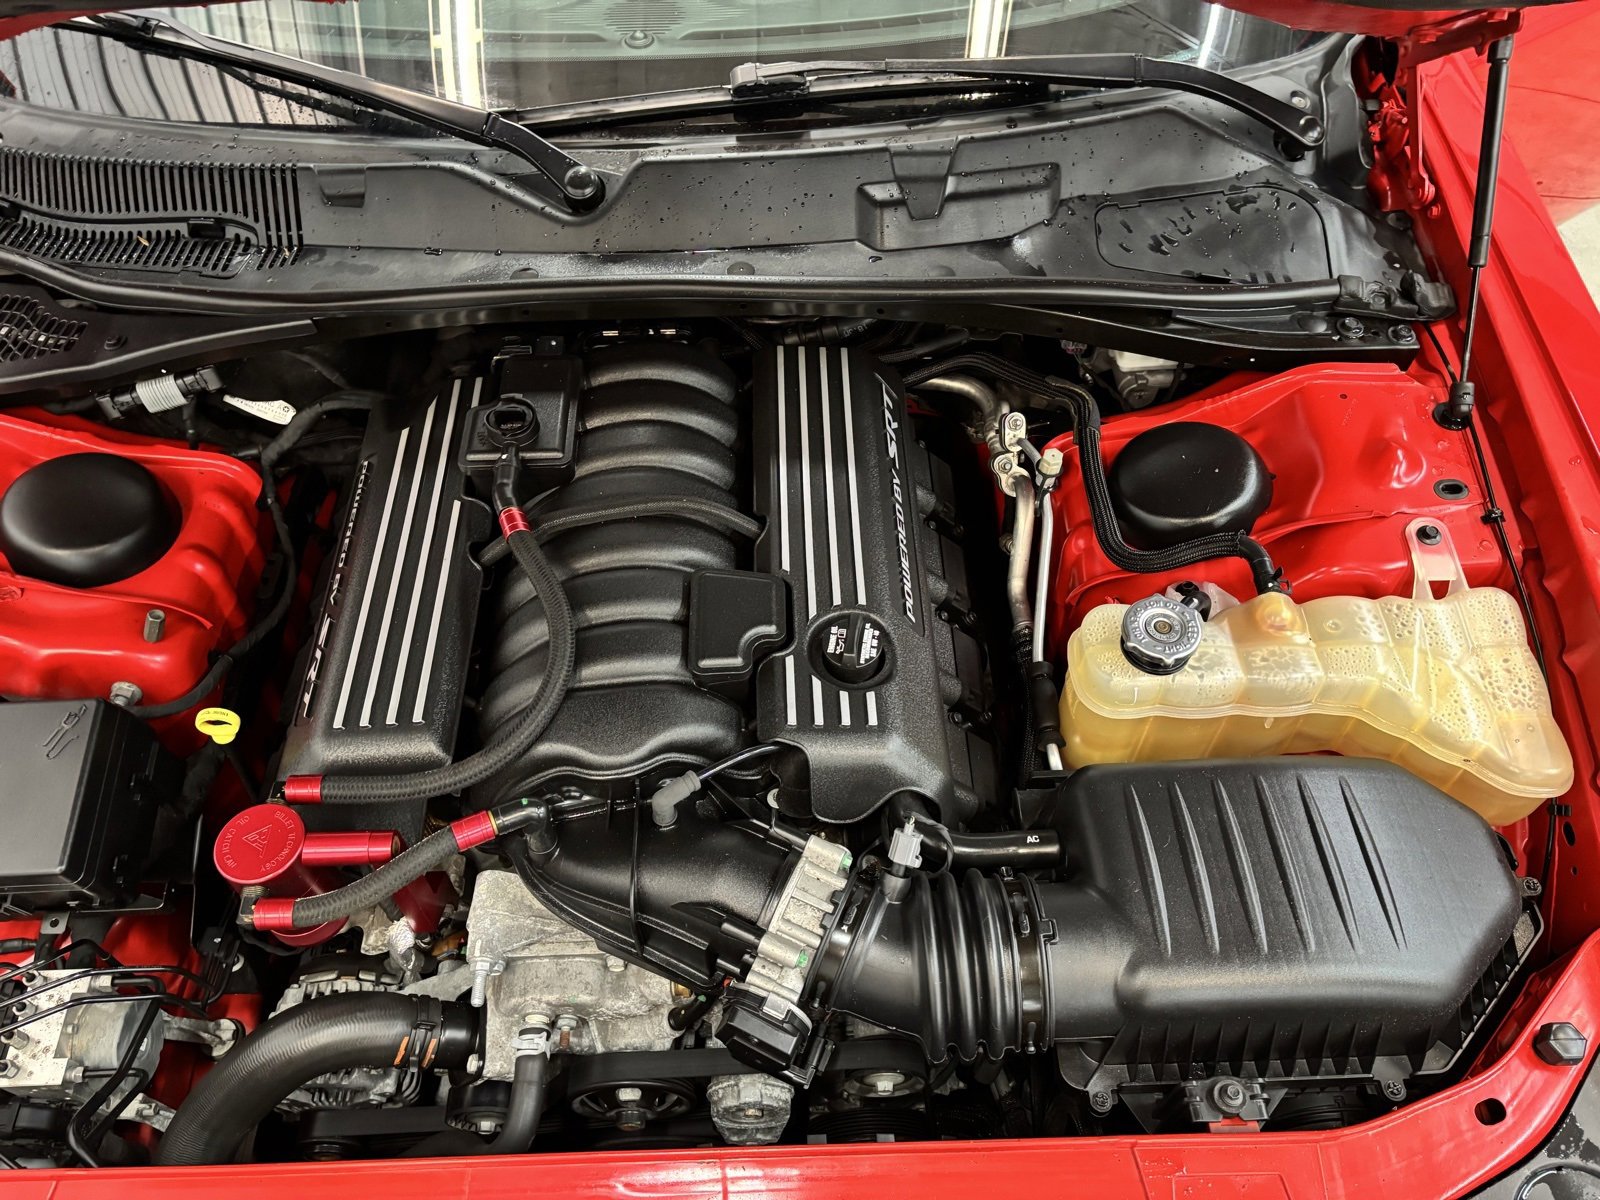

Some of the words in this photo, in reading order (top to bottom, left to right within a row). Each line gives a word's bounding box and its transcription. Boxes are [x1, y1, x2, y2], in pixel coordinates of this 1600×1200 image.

[882, 382, 899, 470] SRT
[891, 467, 903, 504] BY
[338, 460, 369, 568] POWERED
[895, 502, 916, 624] POWERED
[330, 573, 341, 606] BY
[1187, 620, 1198, 643] KEEP
[303, 612, 331, 718] SRT
[236, 815, 250, 826] OIL
[1026, 835, 1040, 844] AC
